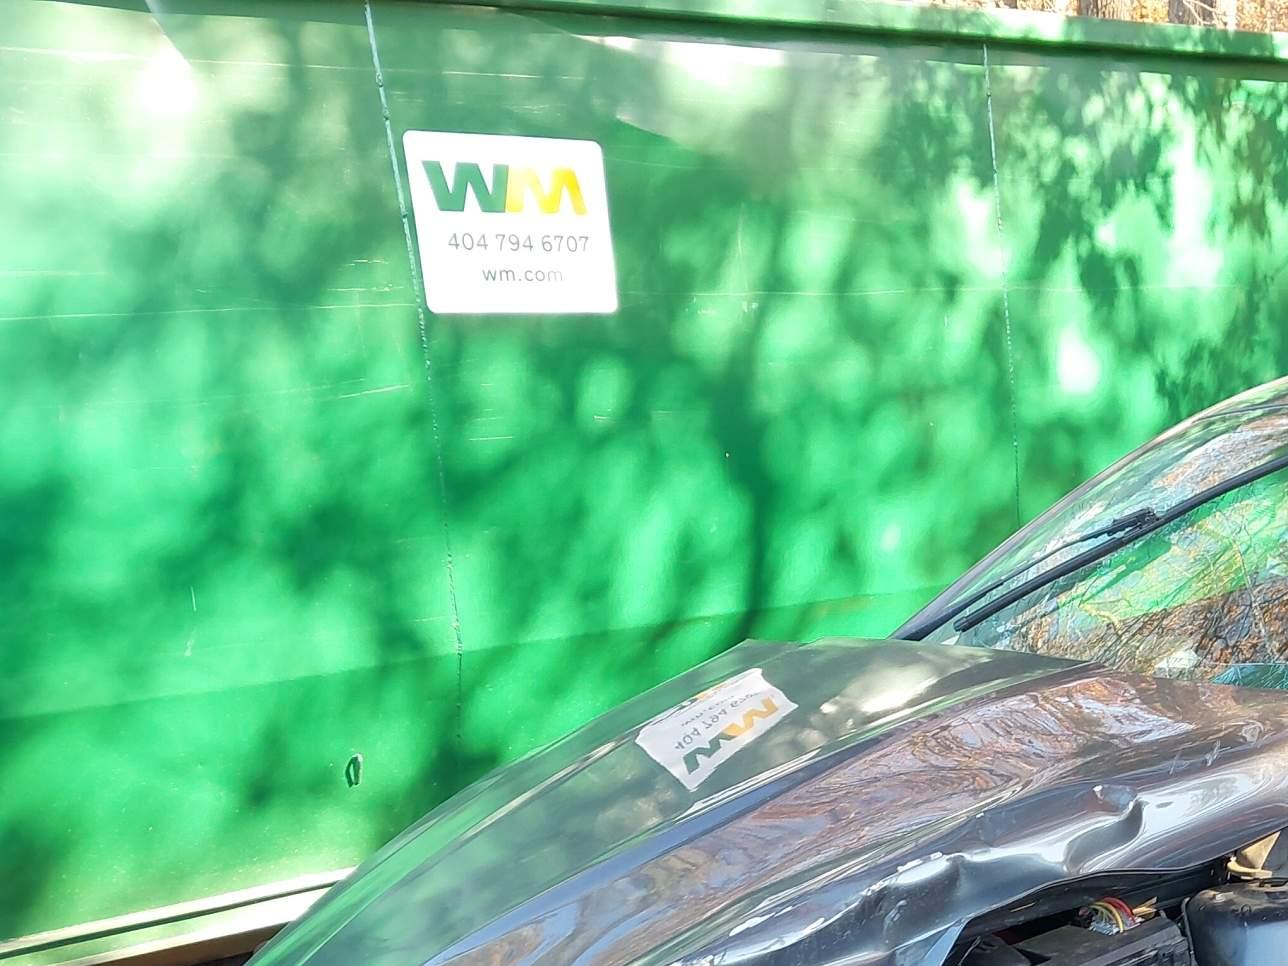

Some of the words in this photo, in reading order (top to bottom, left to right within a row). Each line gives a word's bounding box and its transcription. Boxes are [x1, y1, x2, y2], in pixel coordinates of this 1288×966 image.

[421, 160, 588, 216] WM
[447, 232, 489, 251] 404
[495, 233, 534, 252] 794
[541, 235, 590, 253] 6707
[481, 268, 564, 282] wm.com
